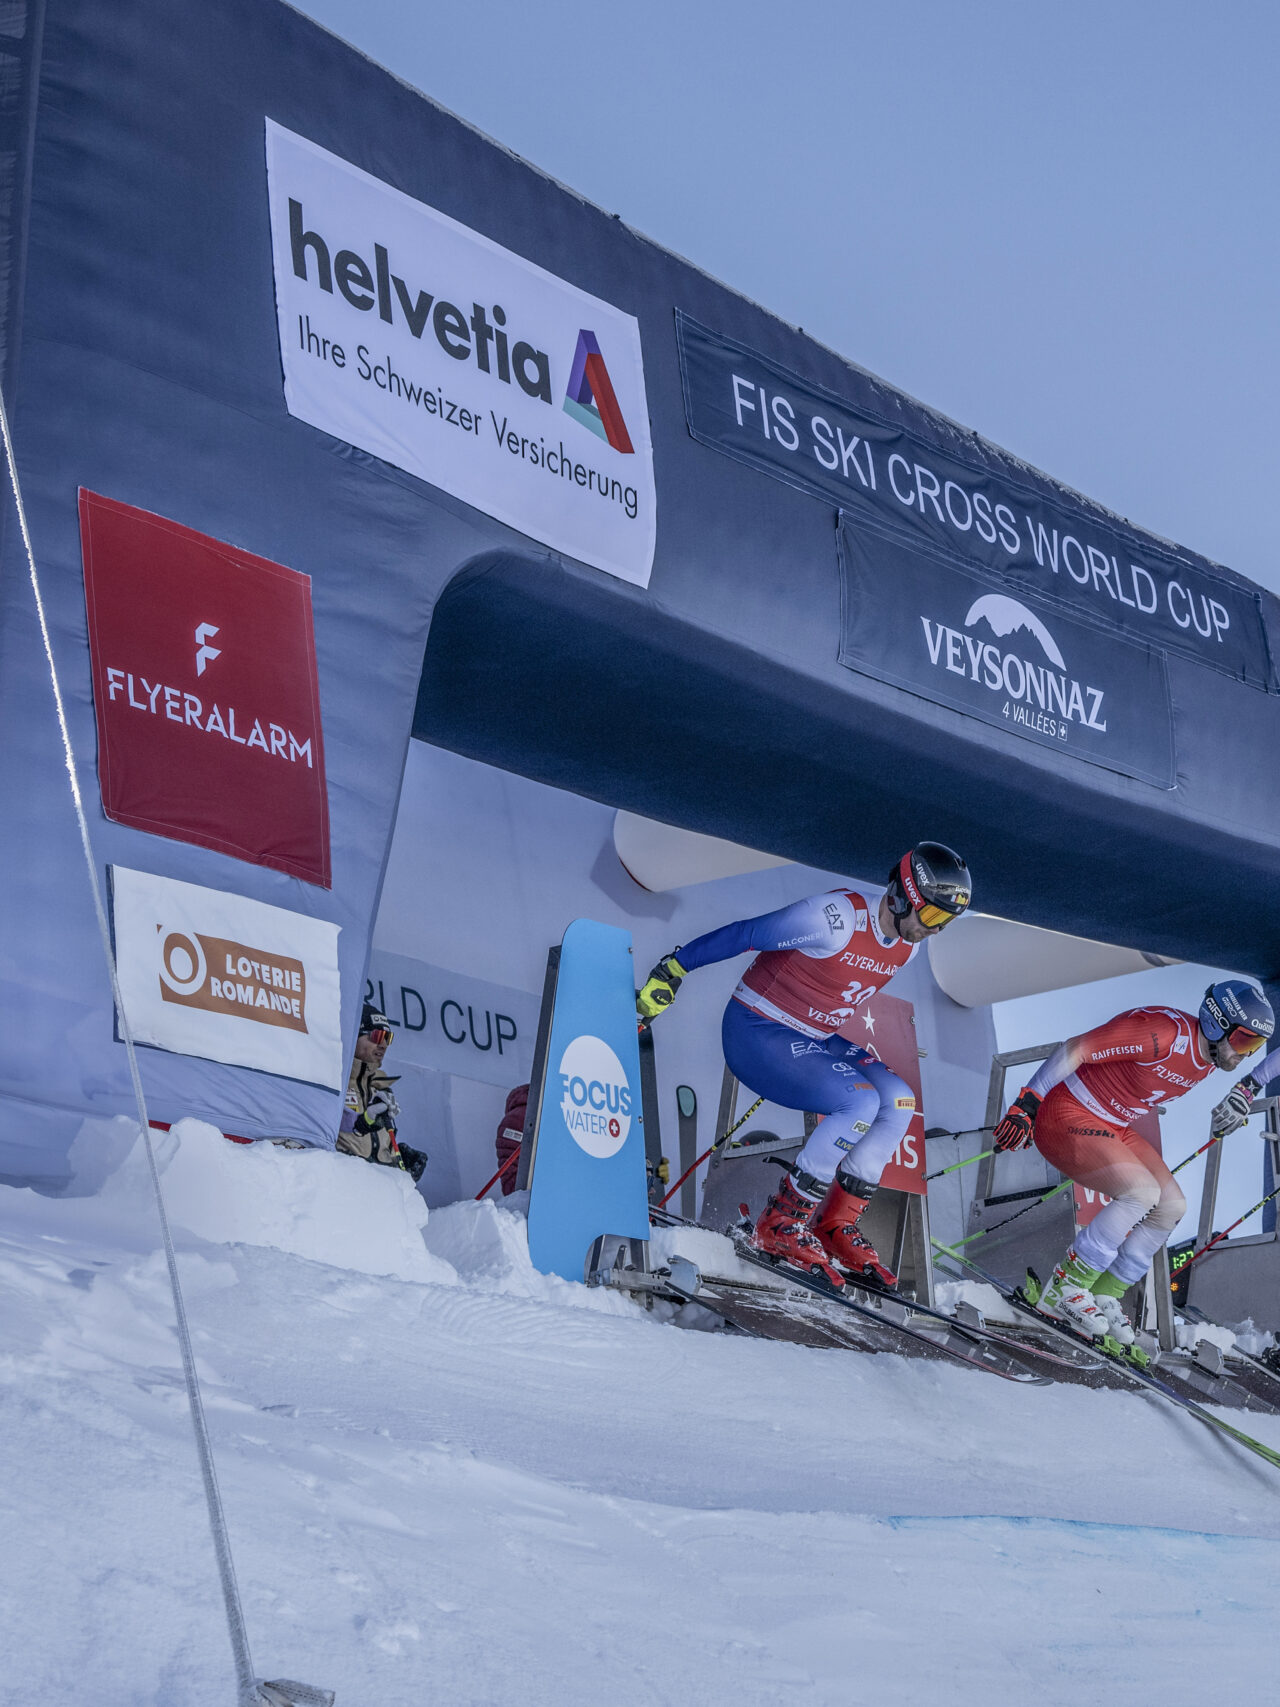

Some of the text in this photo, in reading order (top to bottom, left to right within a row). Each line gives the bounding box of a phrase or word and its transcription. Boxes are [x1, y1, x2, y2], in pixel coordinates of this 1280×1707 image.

[288, 197, 553, 405] helvetia
[298, 314, 638, 519] Ihre Schweizer Versicherung
[732, 374, 1230, 642] FIS SKI CROSS WORLD CUP
[920, 616, 1107, 732] VEYSONNAZ
[106, 666, 313, 769] FLYERALARM
[1002, 701, 1057, 737] 4 VALLÉES
[904, 877, 921, 906] uvex
[915, 863, 930, 887] uvex
[225, 953, 302, 993] LOTERIE
[210, 976, 302, 1019] ROMANDE
[1205, 997, 1230, 1030] GIRO
[440, 999, 518, 1056] CUP
[1091, 1044, 1143, 1061] RAIFFEISEN
[559, 1072, 632, 1116] FOCUS
[564, 1108, 608, 1136] WATER
